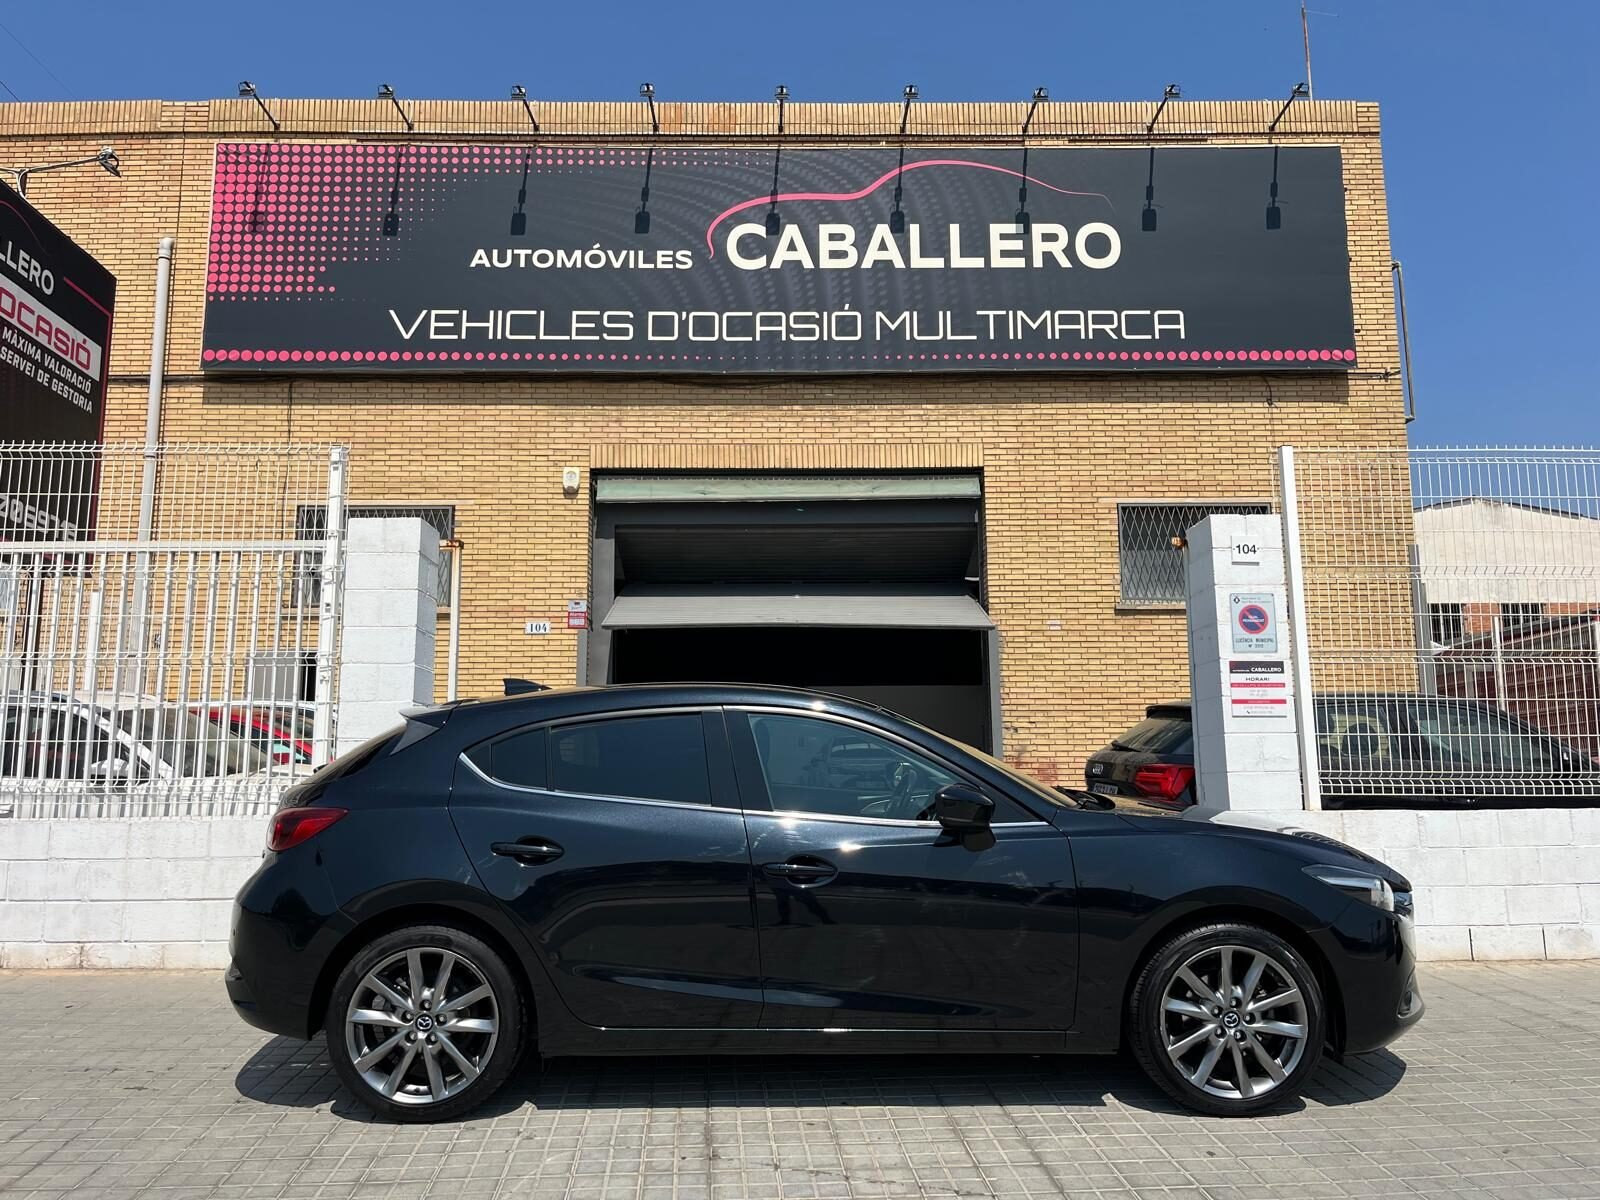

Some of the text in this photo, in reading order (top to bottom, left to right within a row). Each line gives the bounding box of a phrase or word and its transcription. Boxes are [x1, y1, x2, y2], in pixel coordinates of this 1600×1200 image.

[469, 222, 1122, 271] AUTOMÓVILES CABALLERO
[388, 302, 1186, 342] VEHICLES D'OCASIÓ MULTIMARCA
[0, 346, 93, 414] SERVEI DE GESTORIA
[2, 326, 93, 394] MÀXIMA VALORACIÓ
[1235, 544, 1257, 555] 104
[530, 623, 548, 633] 104
